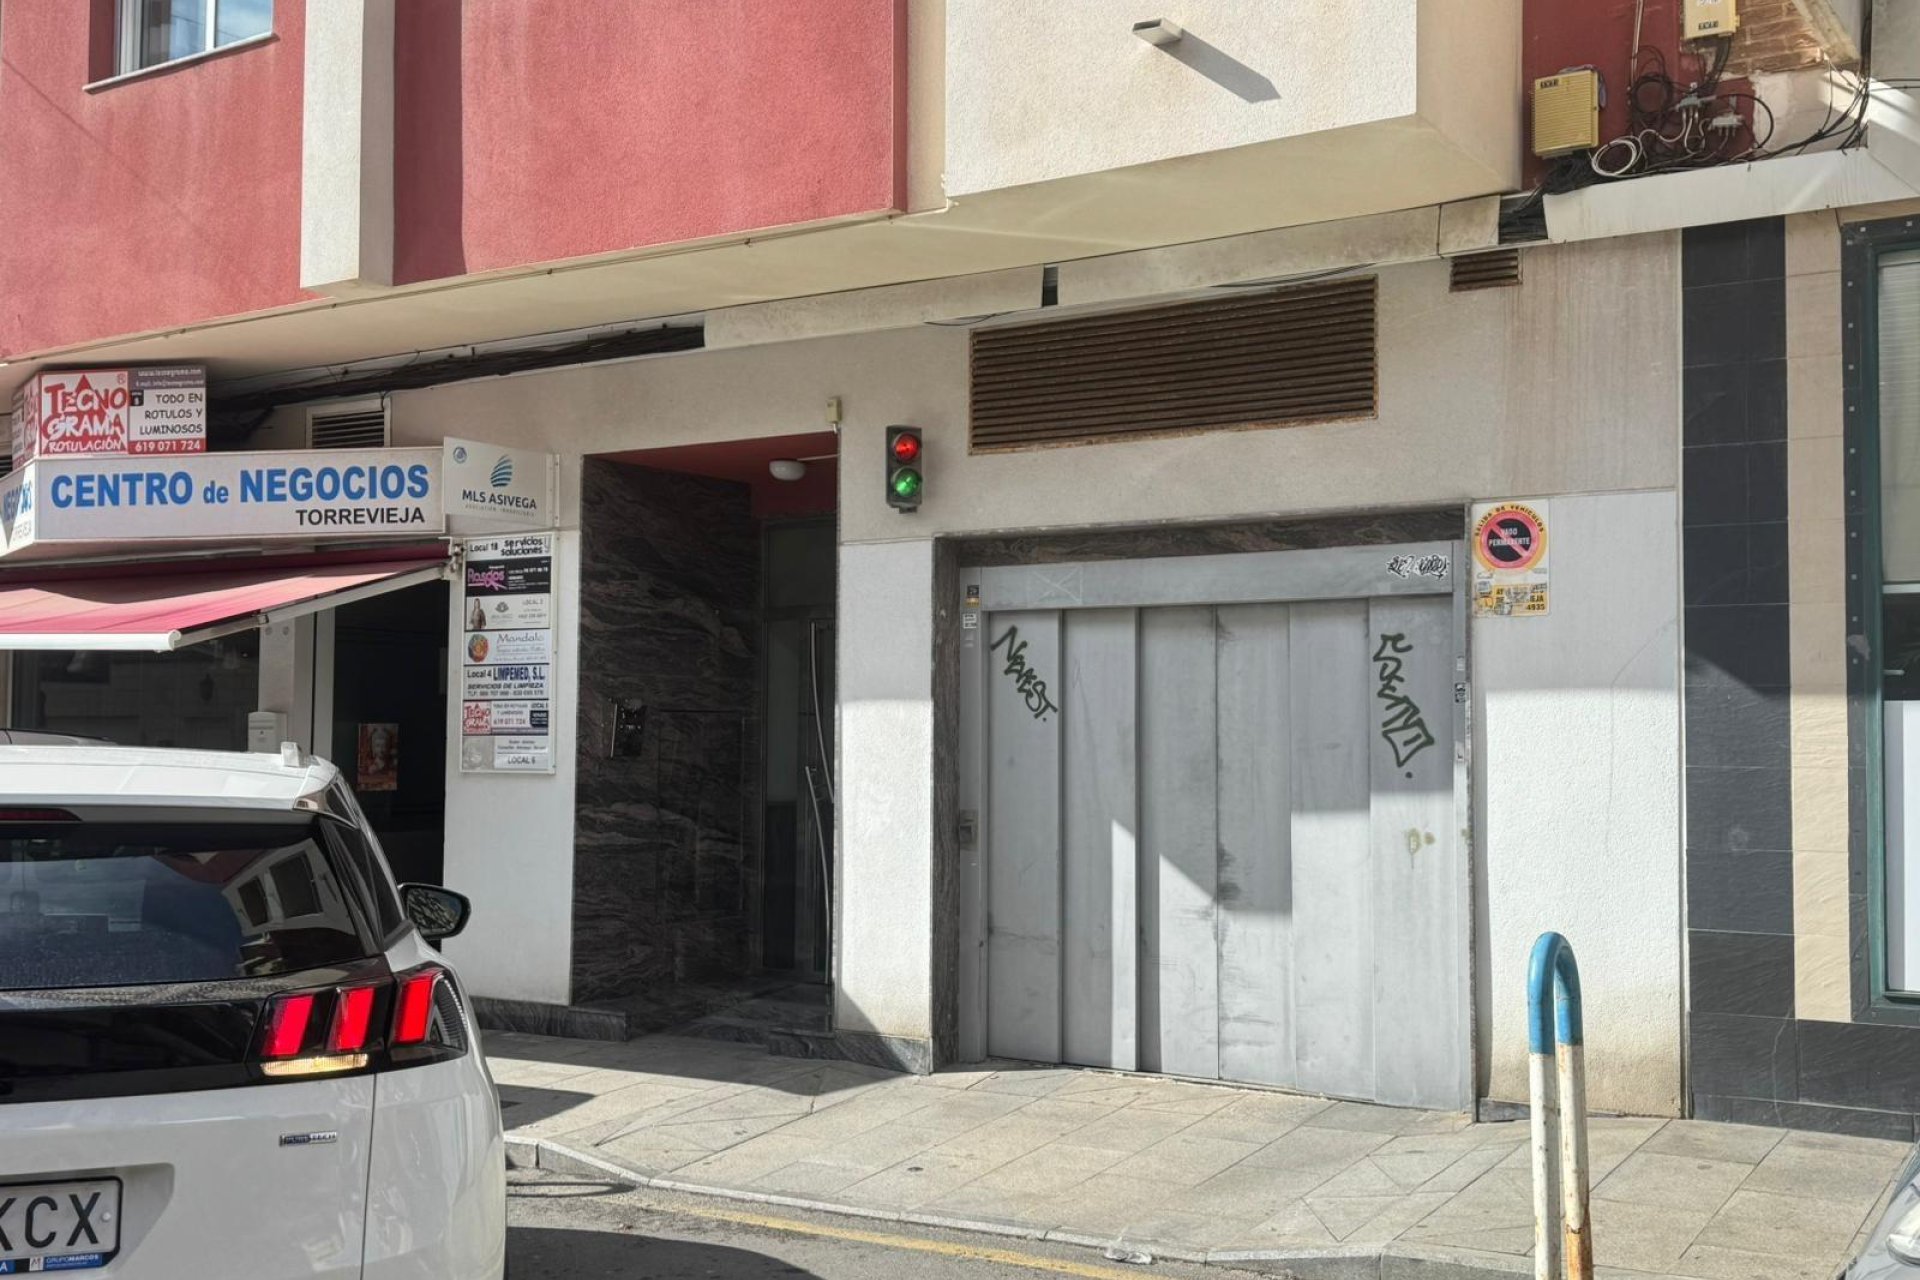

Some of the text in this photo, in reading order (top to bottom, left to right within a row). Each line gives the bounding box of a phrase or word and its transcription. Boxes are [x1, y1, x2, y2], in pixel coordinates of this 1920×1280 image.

[44, 382, 127, 416] TECNO
[156, 393, 203, 404] TODO EN
[145, 408, 202, 419] ROTULOS Y
[42, 413, 125, 440] GRAMA
[140, 424, 203, 435] LUMINOSOS
[48, 436, 121, 453] ROTULACIÓN
[135, 440, 200, 452] 619 071 724
[51, 472, 193, 508] CENTRO
[203, 480, 229, 504] de
[240, 464, 429, 503] NEGOCIOS
[462, 489, 537, 509] MLS ASIVEGA
[296, 507, 425, 526] TORREVIEJA
[470, 543, 488, 552] Local
[467, 670, 486, 678] Local
